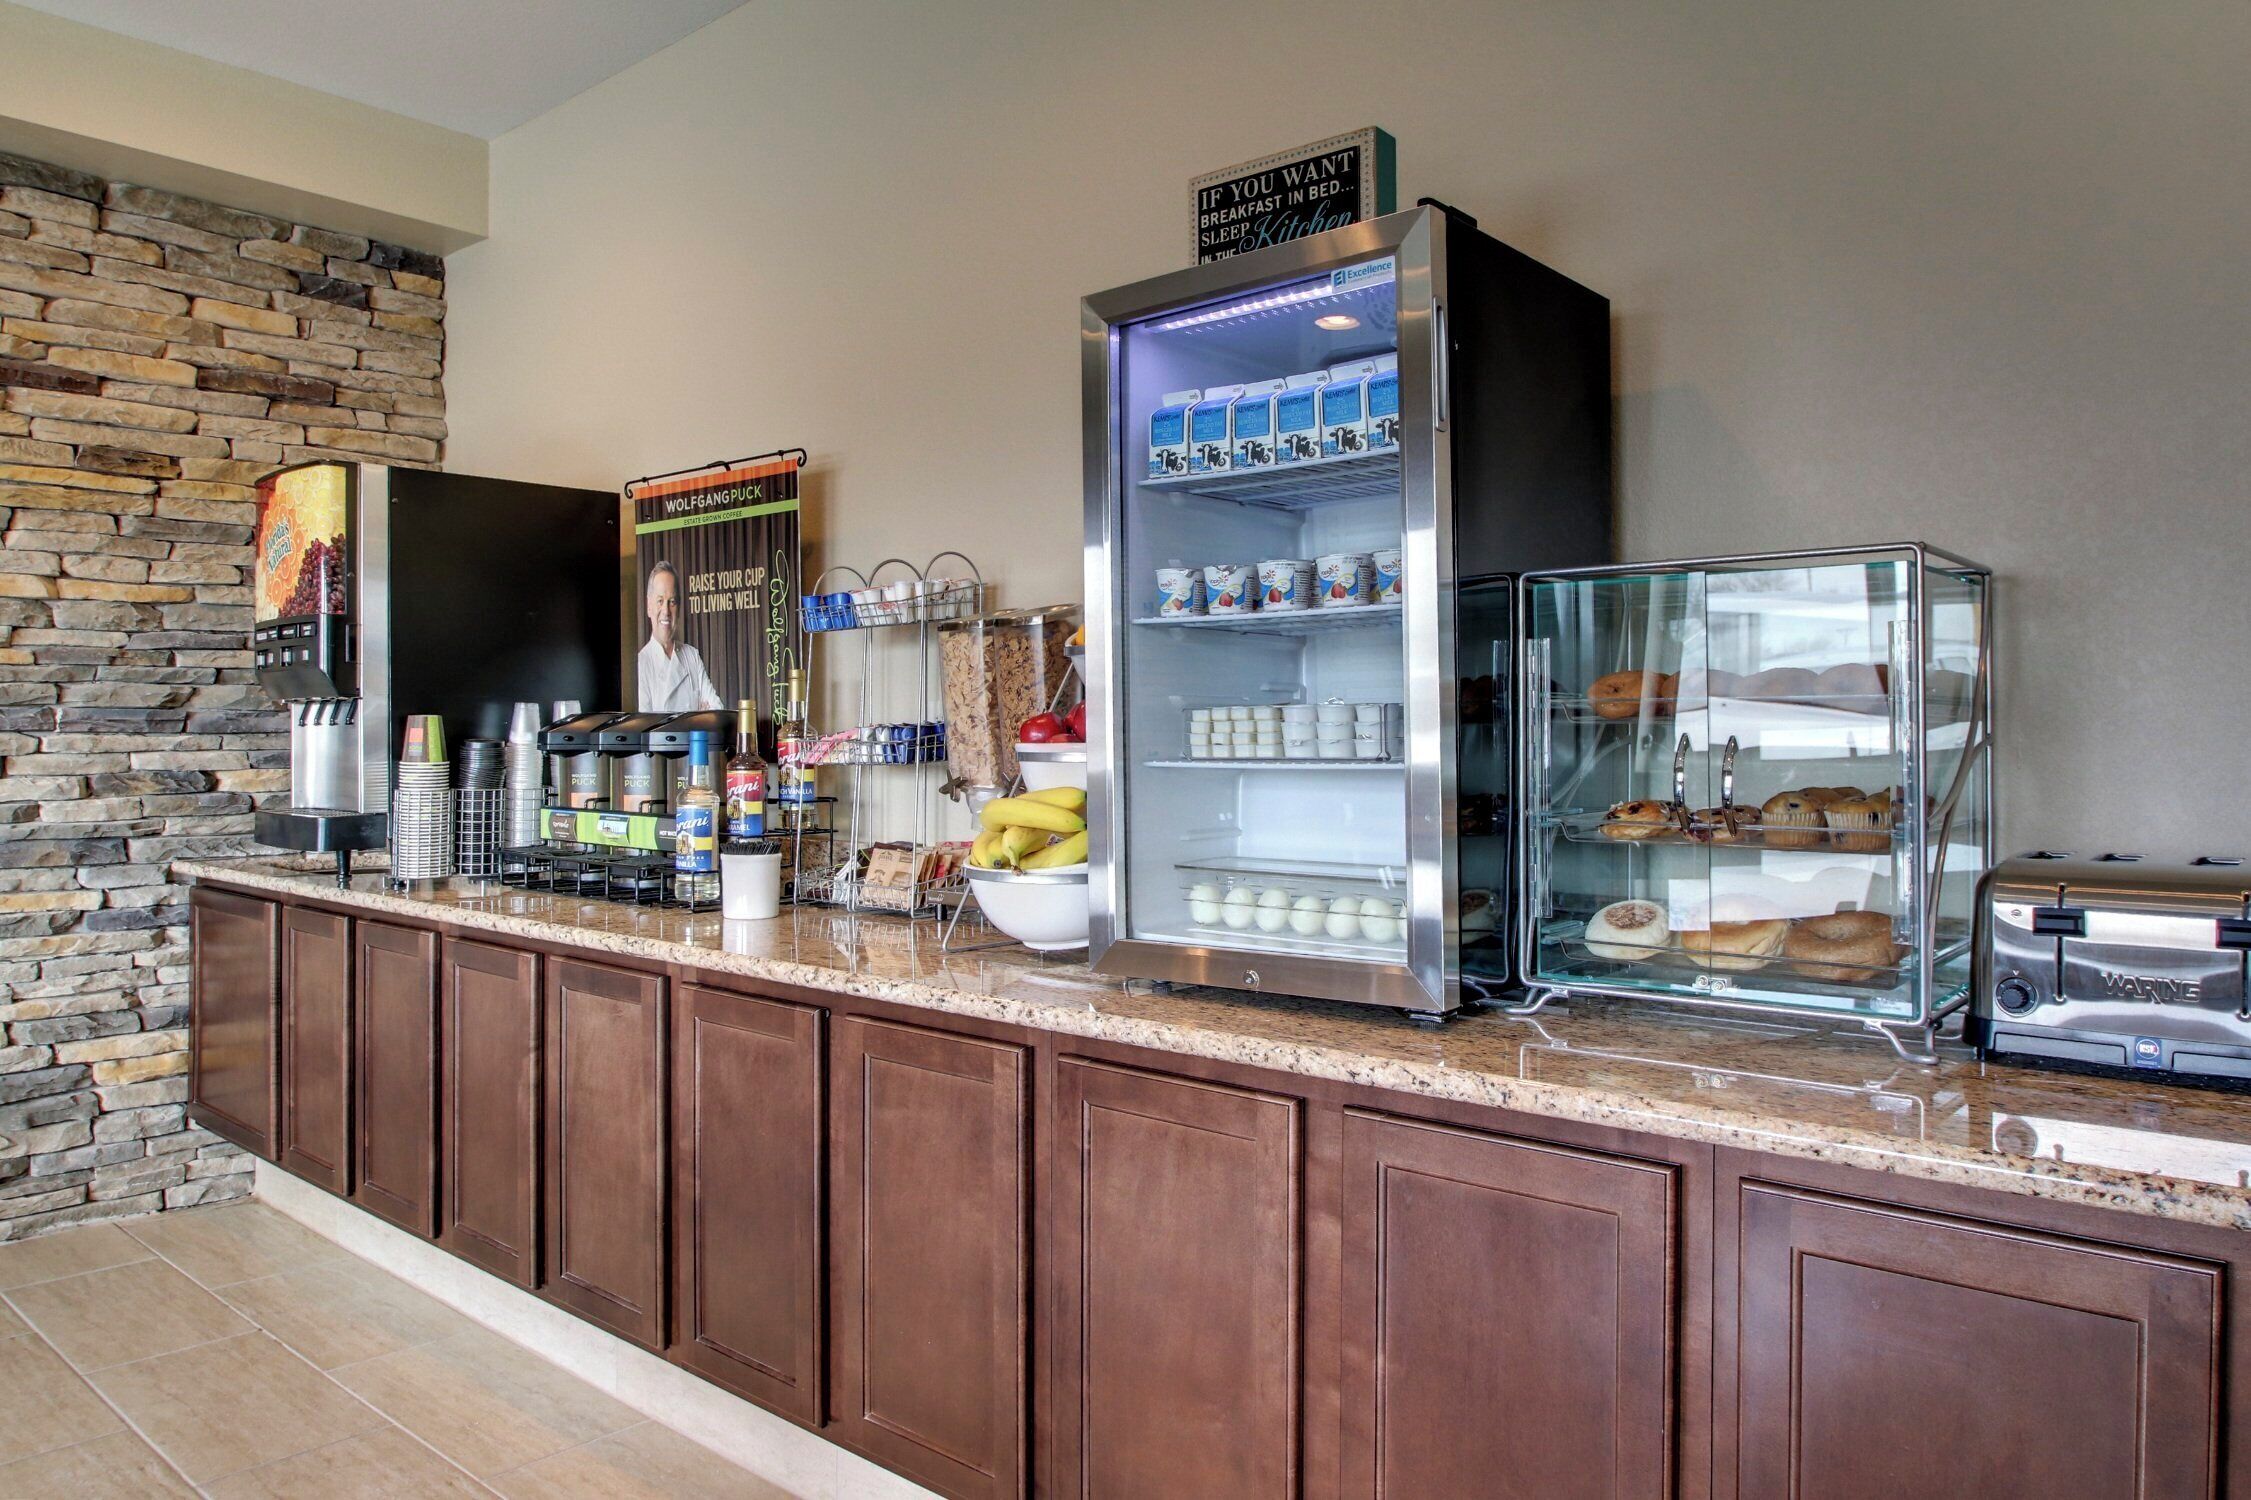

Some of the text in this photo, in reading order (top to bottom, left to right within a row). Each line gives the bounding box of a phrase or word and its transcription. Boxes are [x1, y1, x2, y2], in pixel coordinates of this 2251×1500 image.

[1201, 150, 1354, 210] IF YOU WANT
[1201, 194, 1283, 229] BREAKFAST
[1288, 188, 1304, 206] IN
[1201, 221, 1250, 247] SLEEP
[1347, 261, 1392, 279] Excellence
[684, 510, 743, 526] ESTATE GROWN COFFEE
[689, 566, 765, 593] RAISE YOUR CUP
[689, 590, 761, 614] TO LIVING WELL
[624, 780, 651, 788] PUCK
[2101, 972, 2200, 1004] WARING
